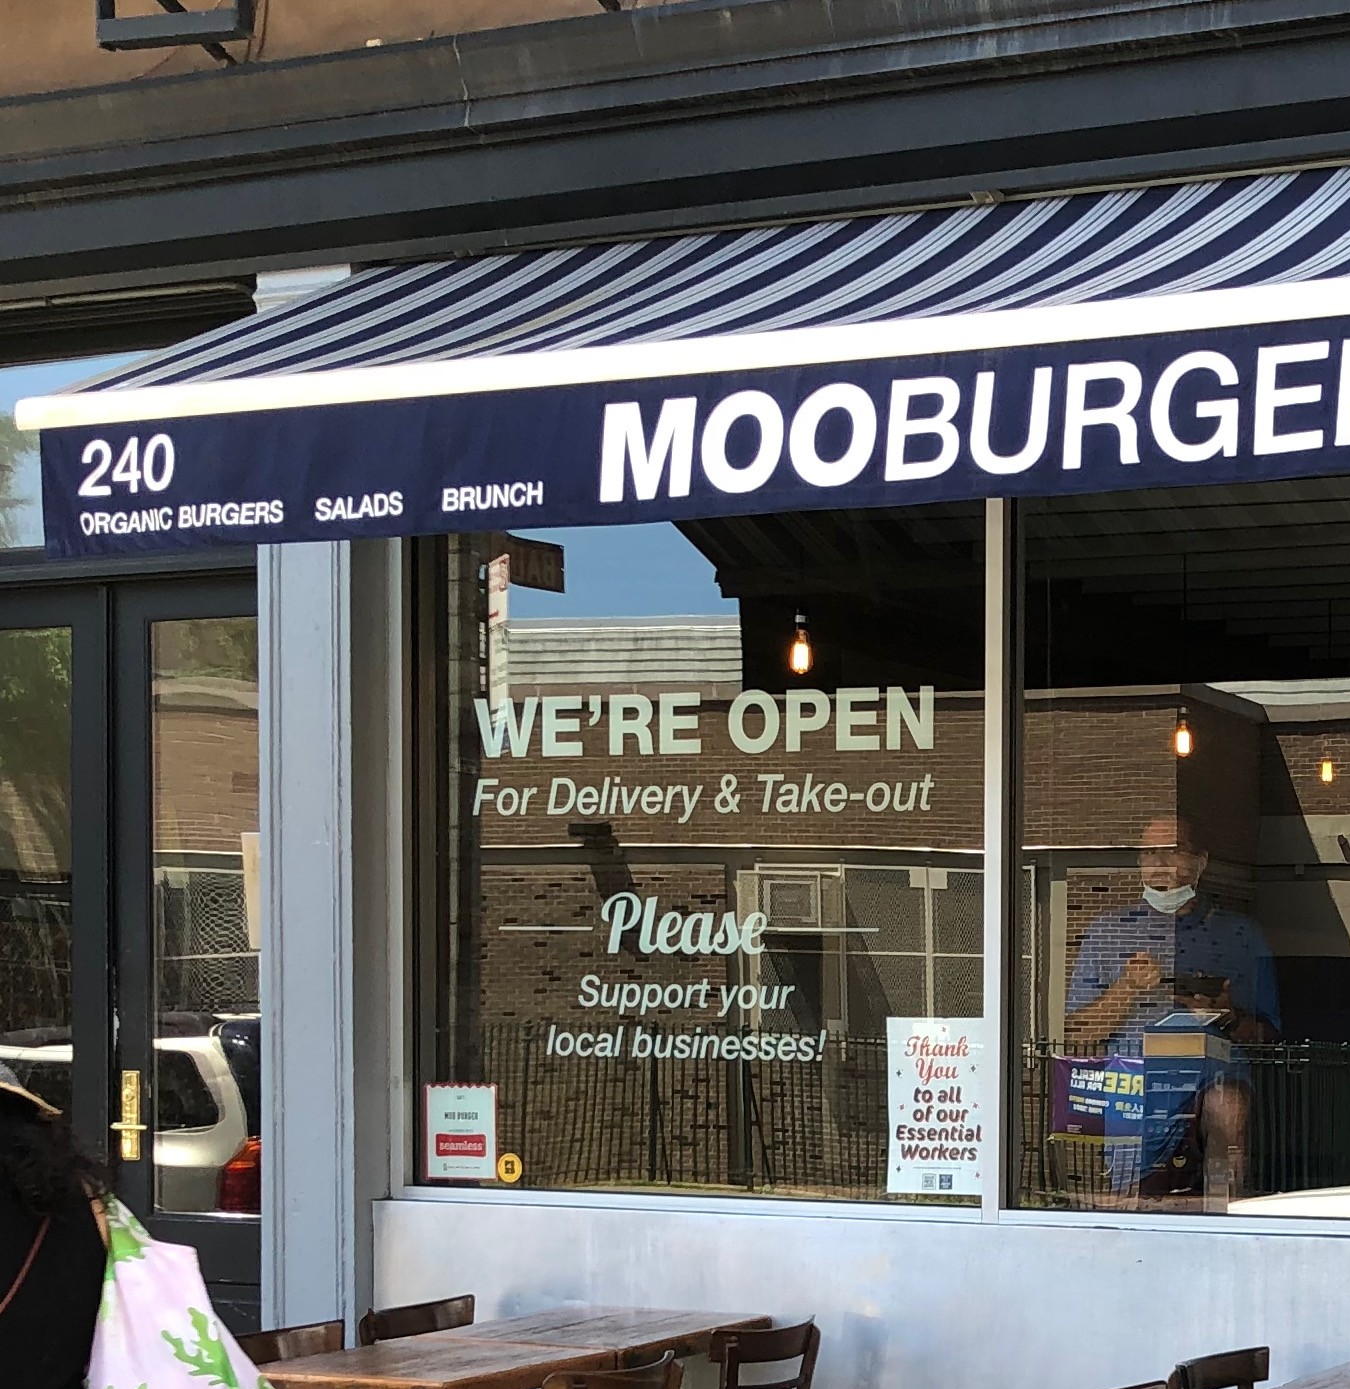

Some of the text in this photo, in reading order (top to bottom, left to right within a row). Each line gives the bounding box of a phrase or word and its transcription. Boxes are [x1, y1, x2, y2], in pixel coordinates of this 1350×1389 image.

[78, 433, 175, 496] 240
[315, 491, 403, 521] SALADS
[441, 480, 543, 512] BRUNCH
[80, 500, 284, 536] ORGANIC BURGERS
[473, 685, 935, 758] WE'RE OPEN
[473, 773, 934, 824] For Delivery & Take-out
[601, 892, 768, 954] Please
[578, 975, 795, 1016] Support your
[546, 1026, 827, 1061] local businesses!
[904, 1035, 970, 1057] Thank
[915, 1058, 959, 1086] You
[913, 1086, 962, 1104] to all
[912, 1105, 969, 1123] of our
[439, 1140, 483, 1151] seamless
[896, 1124, 982, 1142] Essential
[901, 1143, 978, 1161] Workers
